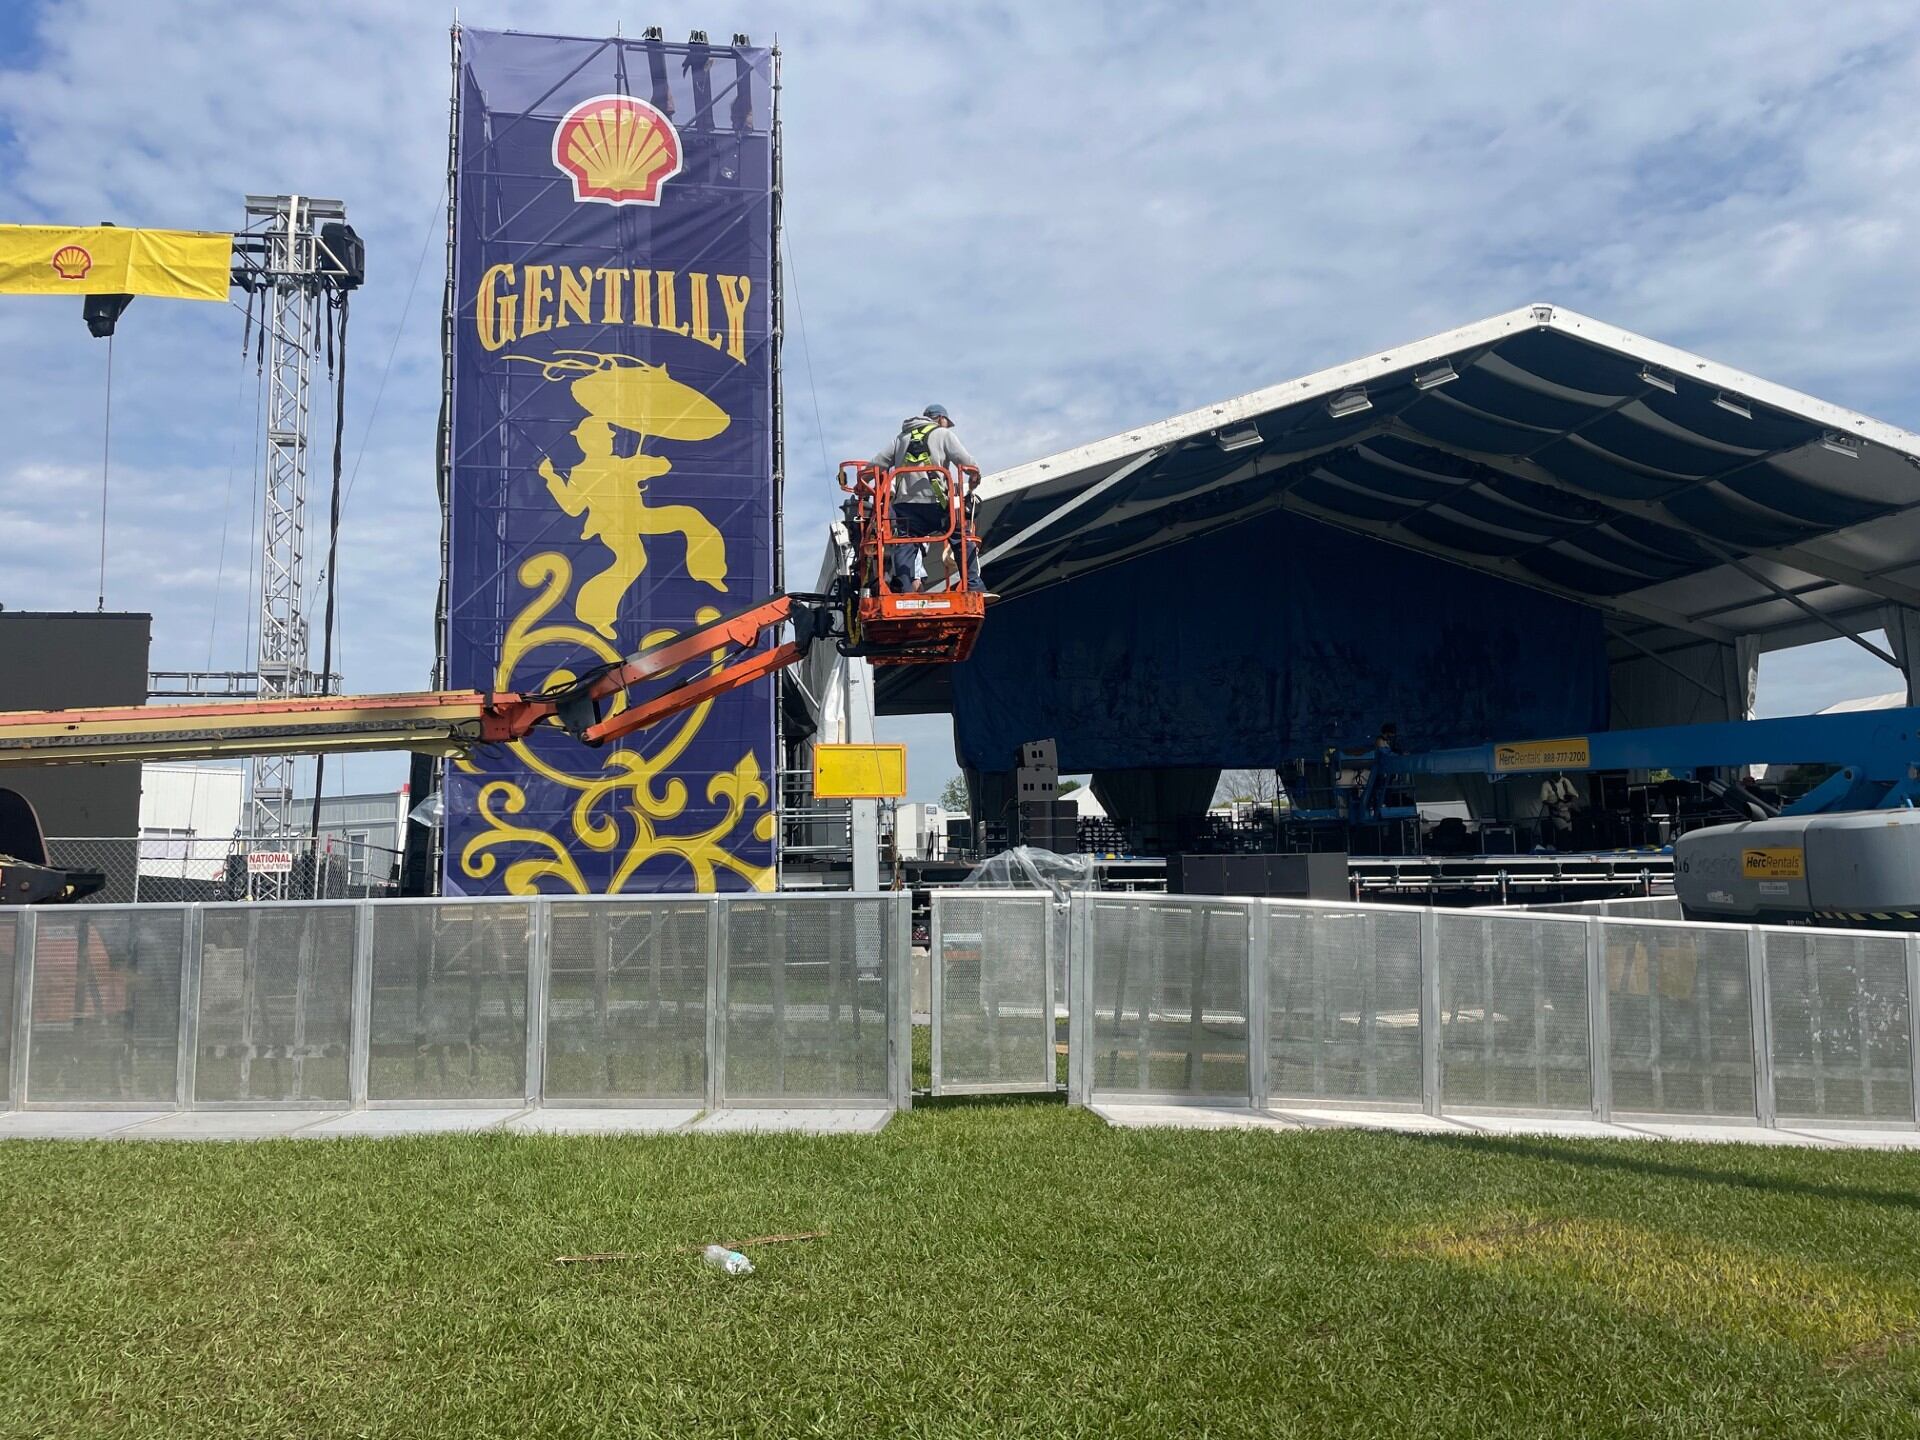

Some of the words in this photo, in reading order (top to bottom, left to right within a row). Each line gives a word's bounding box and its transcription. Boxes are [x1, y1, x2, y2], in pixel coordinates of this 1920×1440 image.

[476, 263, 751, 366] GENTILLY
[249, 853, 291, 863] NATIONAL
[1746, 855, 1800, 868] HercRentals
